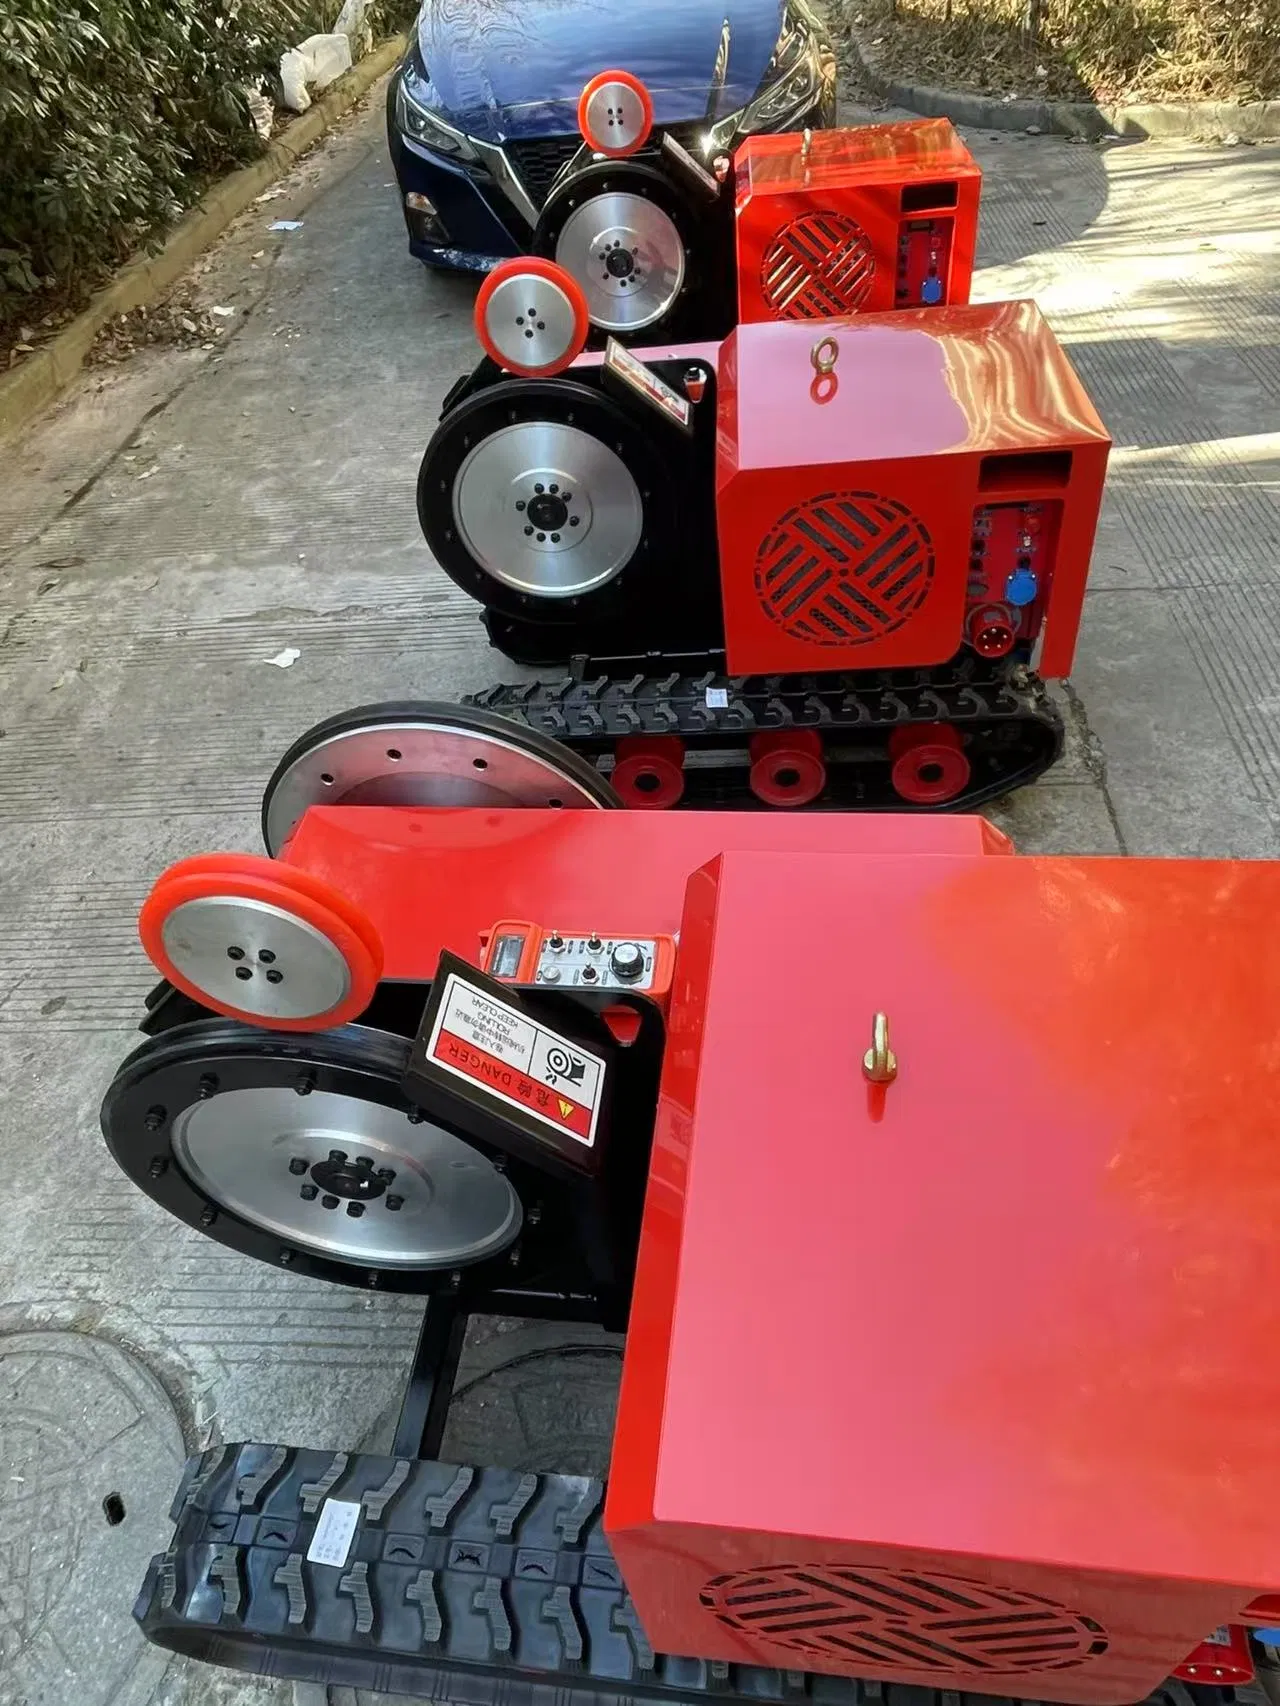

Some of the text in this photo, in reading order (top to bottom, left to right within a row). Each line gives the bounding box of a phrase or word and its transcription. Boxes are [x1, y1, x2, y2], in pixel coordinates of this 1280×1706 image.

[471, 997, 518, 1028] KEEP CLEAR
[477, 1011, 510, 1035] ROLLING
[449, 1044, 511, 1086] DANGER
